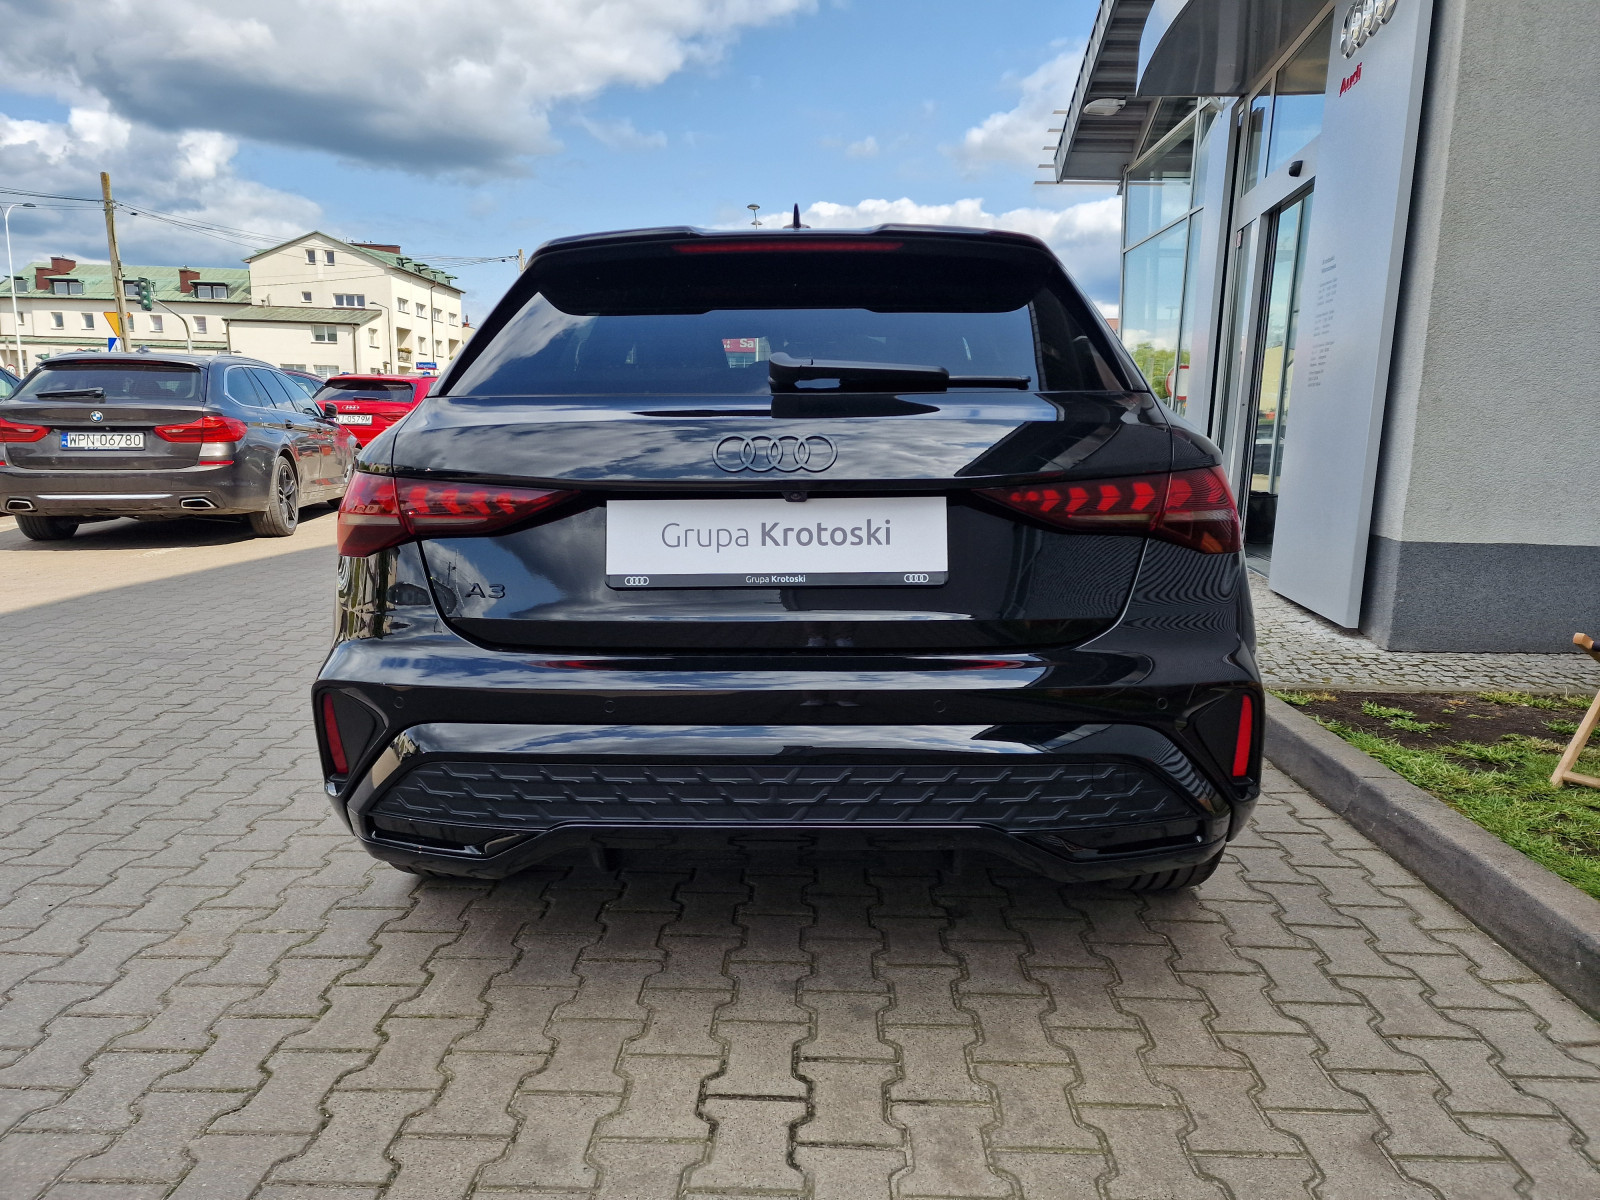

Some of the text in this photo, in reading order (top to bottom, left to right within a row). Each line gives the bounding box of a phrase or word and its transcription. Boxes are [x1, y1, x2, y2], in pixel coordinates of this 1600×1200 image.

[1339, 62, 1362, 97] Audi
[69, 433, 141, 446] WPN 06780
[661, 519, 892, 553] Grupa Krotoski
[745, 574, 806, 585] Grupa Krotoski
[465, 582, 506, 598] A3
